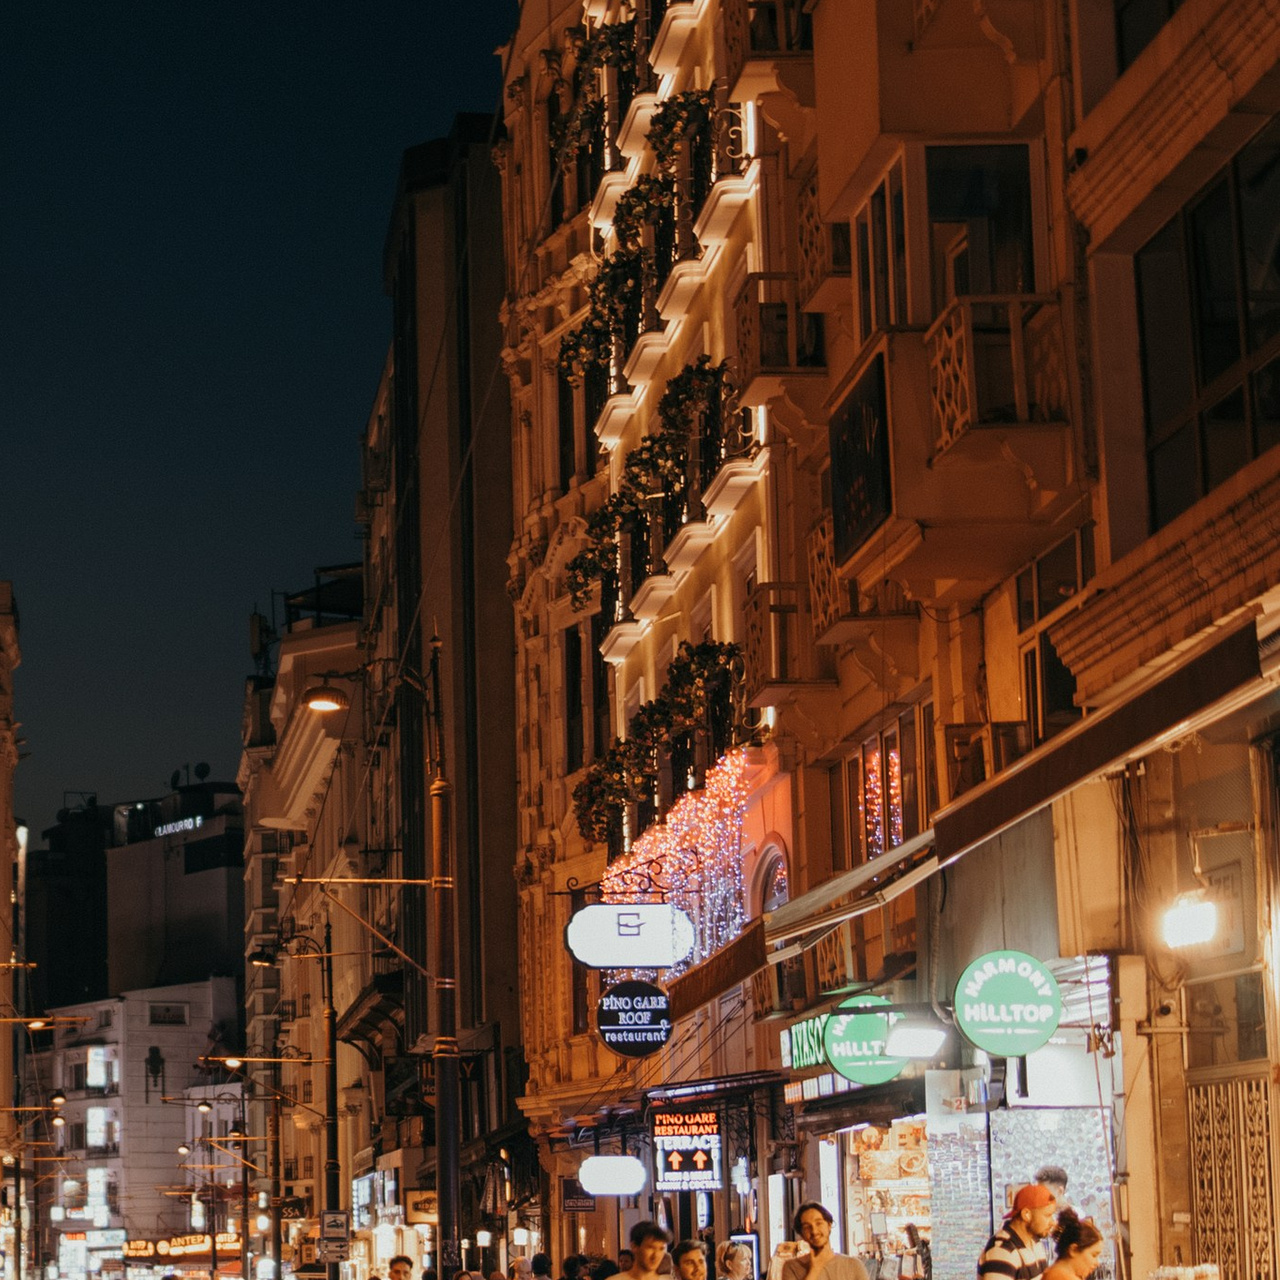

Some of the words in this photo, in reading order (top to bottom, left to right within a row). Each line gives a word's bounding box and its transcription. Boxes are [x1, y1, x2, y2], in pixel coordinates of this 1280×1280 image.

[965, 958, 1053, 998] HARMONY
[618, 1012, 651, 1024] ROOF
[605, 1030, 666, 1042] restaurant
[654, 1124, 718, 1135] RESTAURANT
[653, 1135, 721, 1150] TERRACE
[170, 1235, 204, 1247] ANTEP
